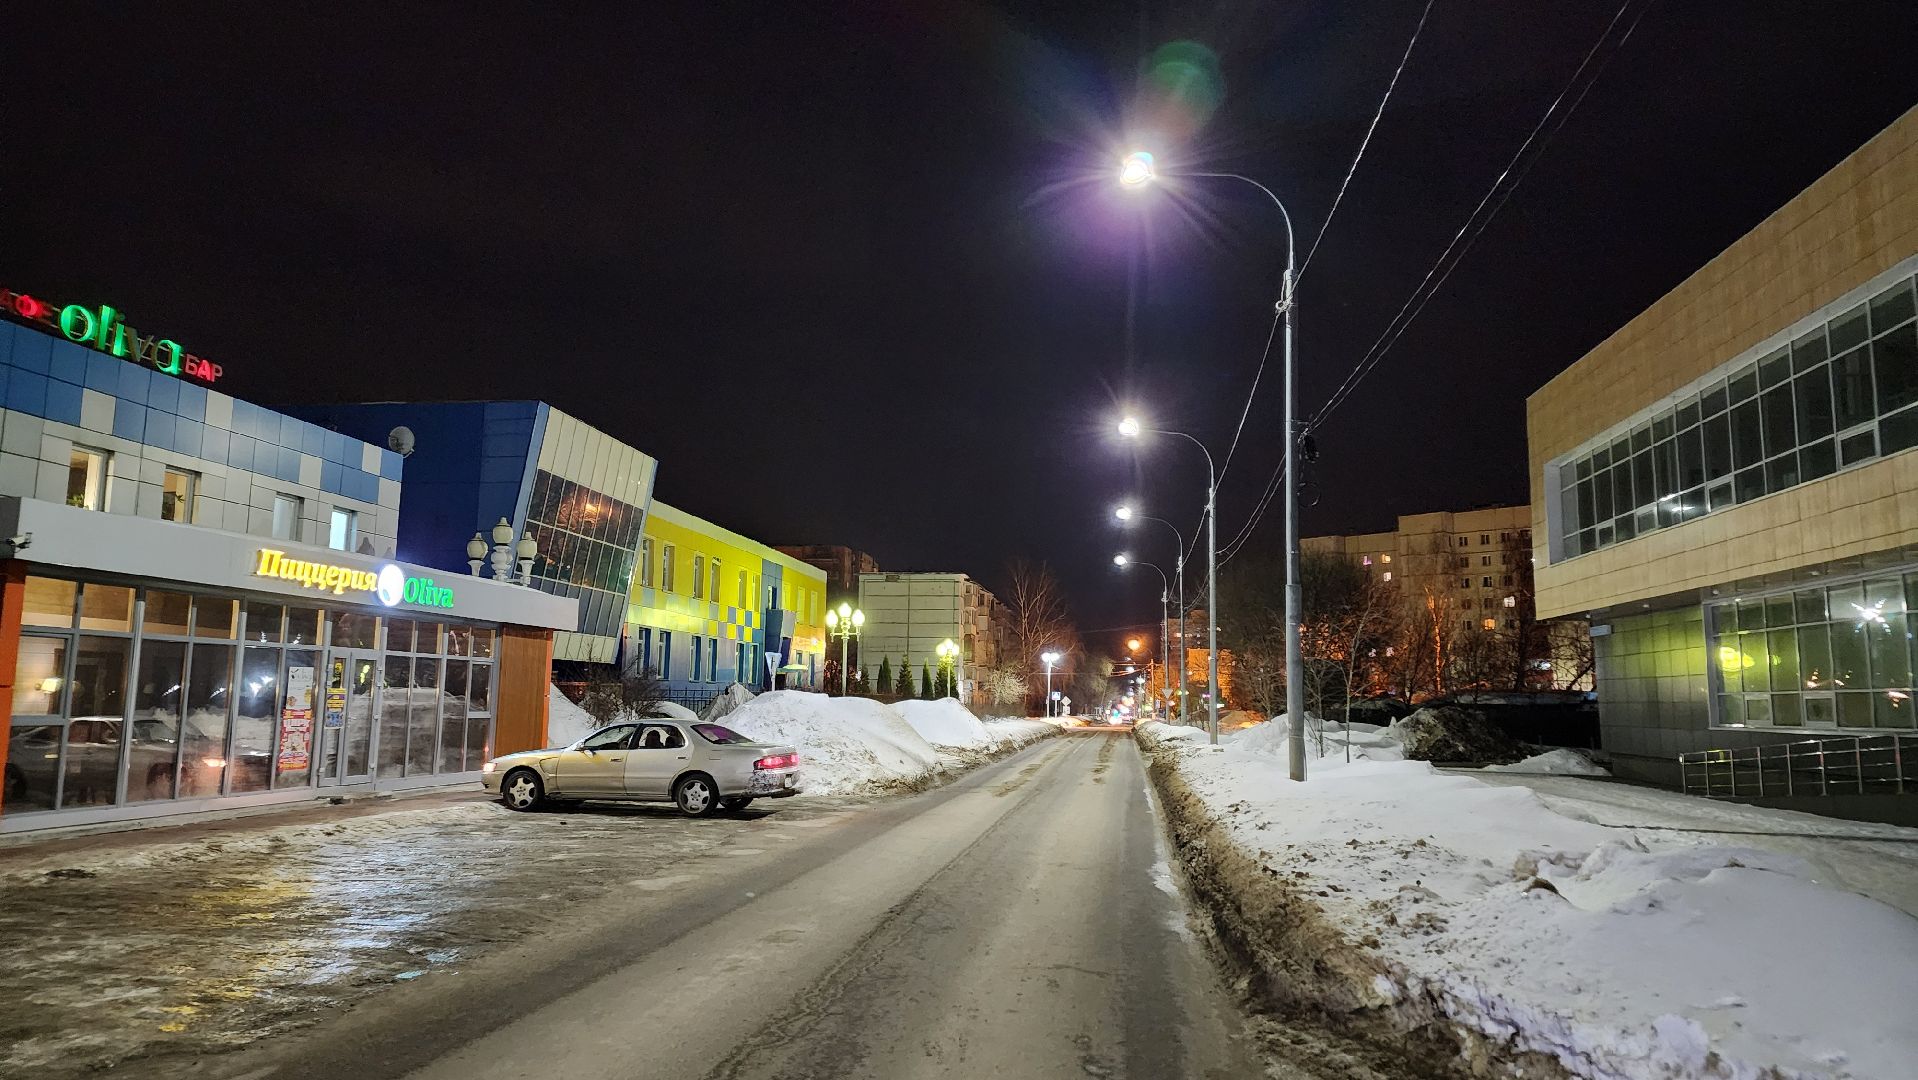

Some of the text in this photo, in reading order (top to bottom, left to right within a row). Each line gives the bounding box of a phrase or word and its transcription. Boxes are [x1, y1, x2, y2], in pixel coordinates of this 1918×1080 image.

[59, 304, 184, 375] oliva
[185, 353, 223, 383] БАР
[256, 548, 454, 608] Пиццерия Oliva
